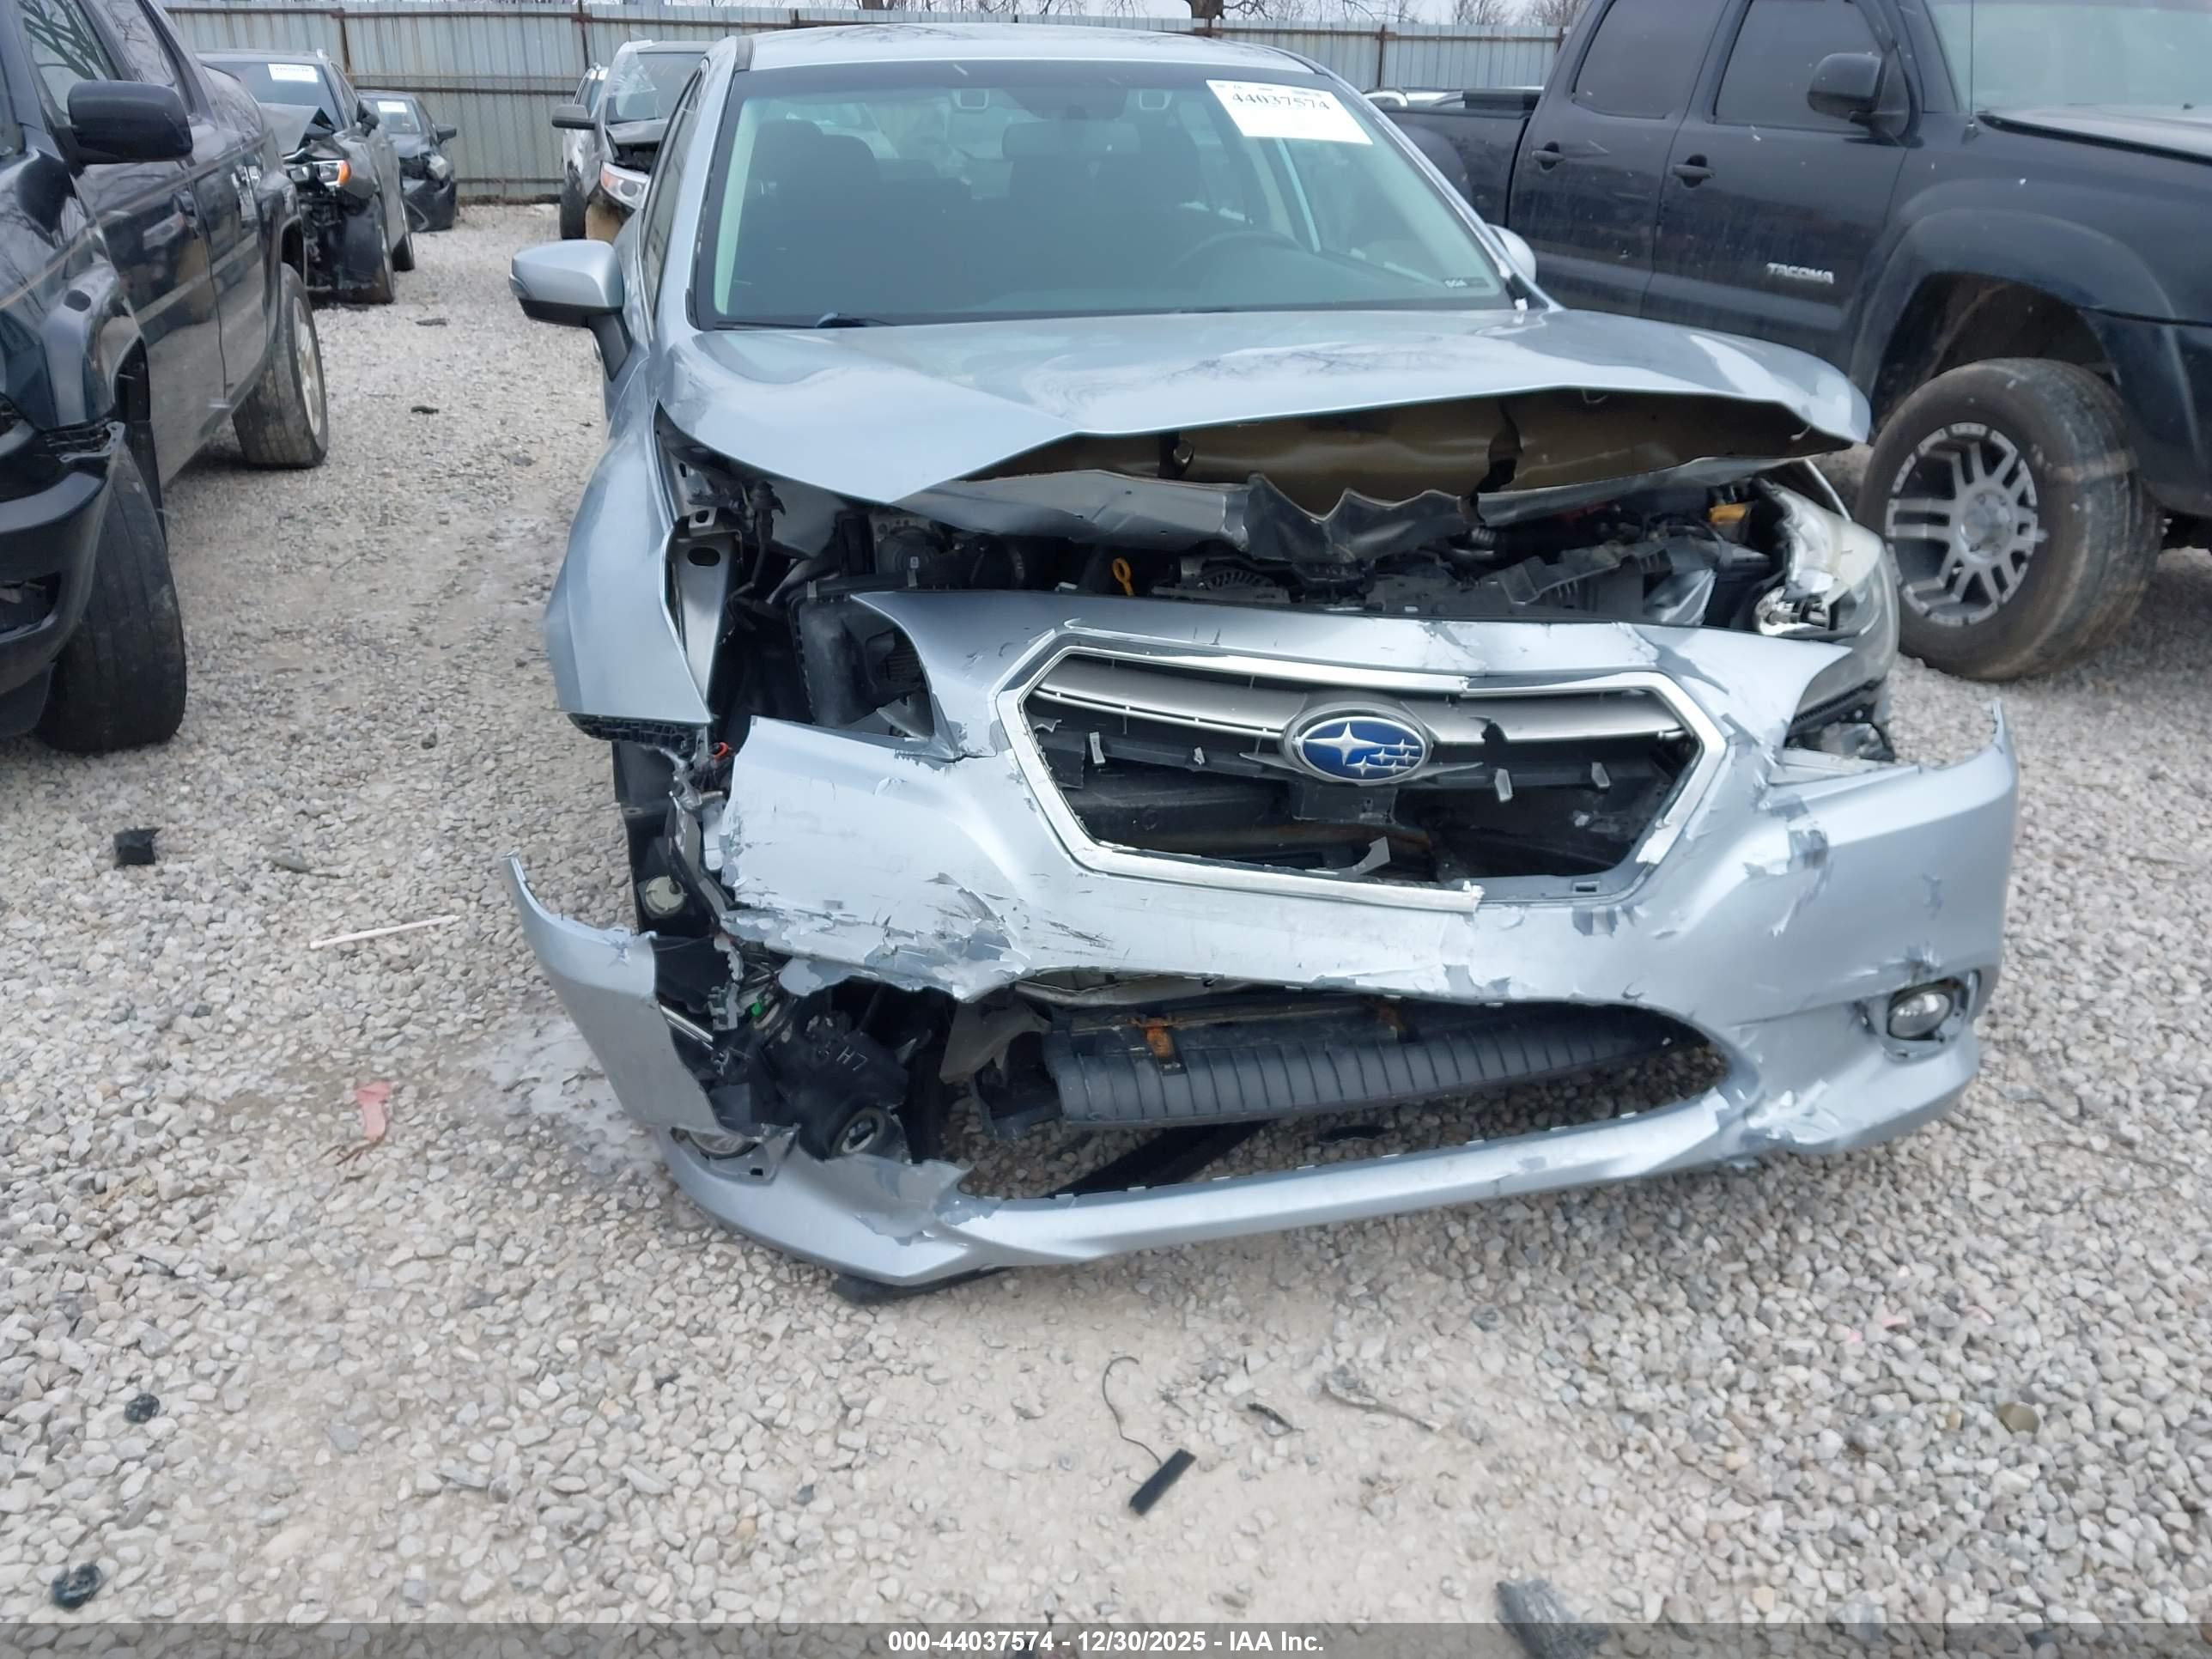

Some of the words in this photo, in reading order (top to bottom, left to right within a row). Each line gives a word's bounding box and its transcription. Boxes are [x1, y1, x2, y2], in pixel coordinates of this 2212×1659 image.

[1232, 93, 1330, 110] 44037574
[1766, 262, 1835, 285] TACOMA
[836, 1045, 868, 1072] H7
